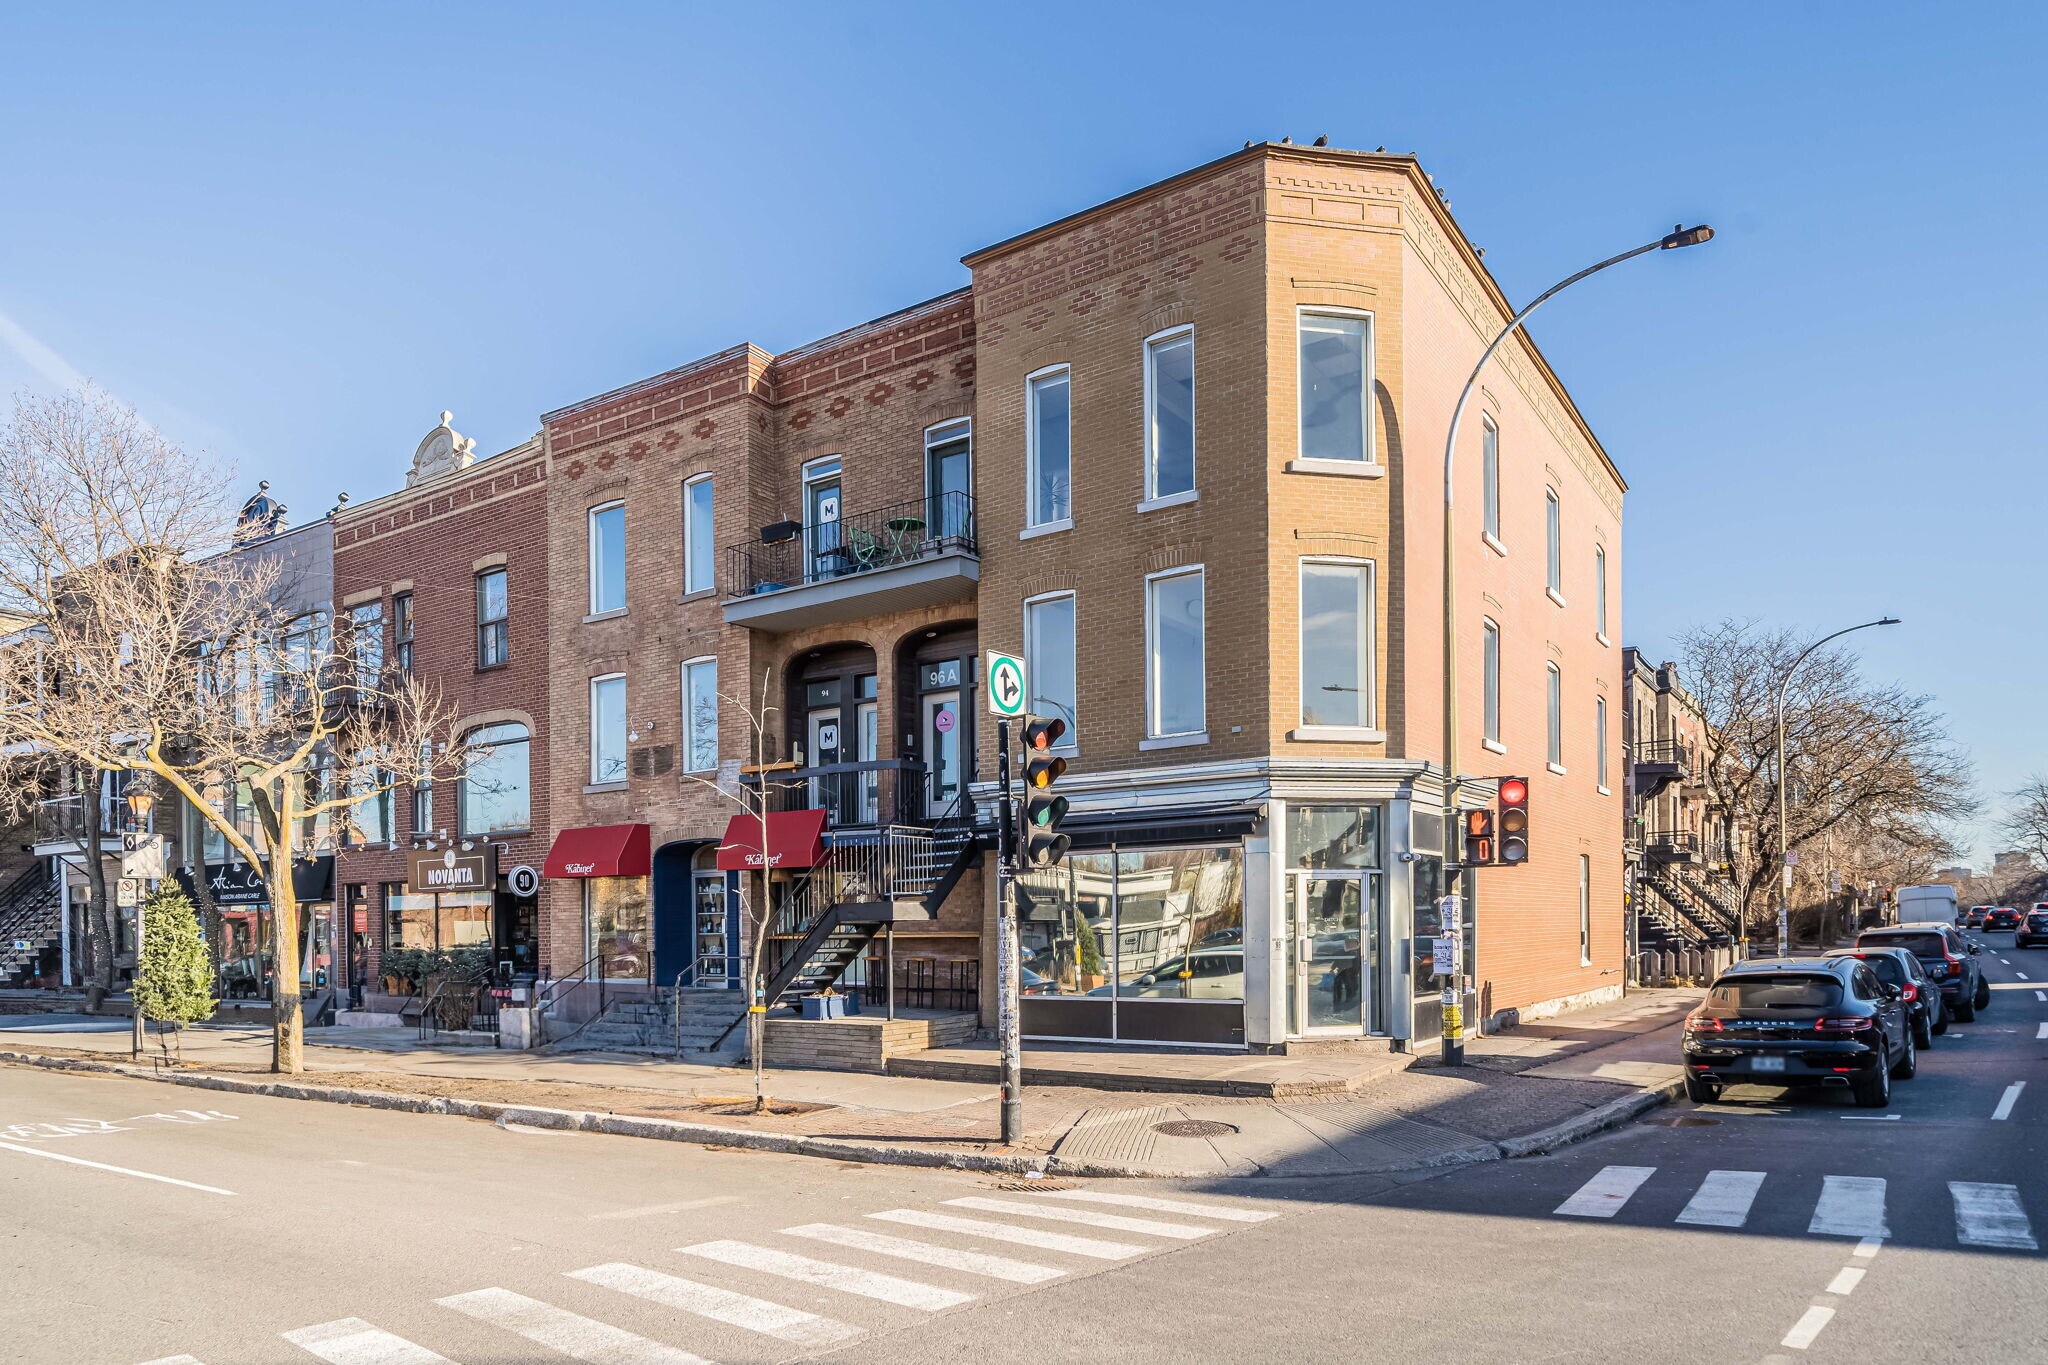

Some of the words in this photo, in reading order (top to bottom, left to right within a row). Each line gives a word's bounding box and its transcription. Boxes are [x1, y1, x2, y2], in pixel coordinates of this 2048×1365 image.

[825, 504, 834, 515] M
[824, 731, 833, 743] M
[1479, 839, 1489, 861] 0
[744, 852, 782, 867] Kabnet
[565, 862, 595, 875] Kabinet
[427, 867, 474, 885] NOVANTA
[519, 874, 530, 888] 90
